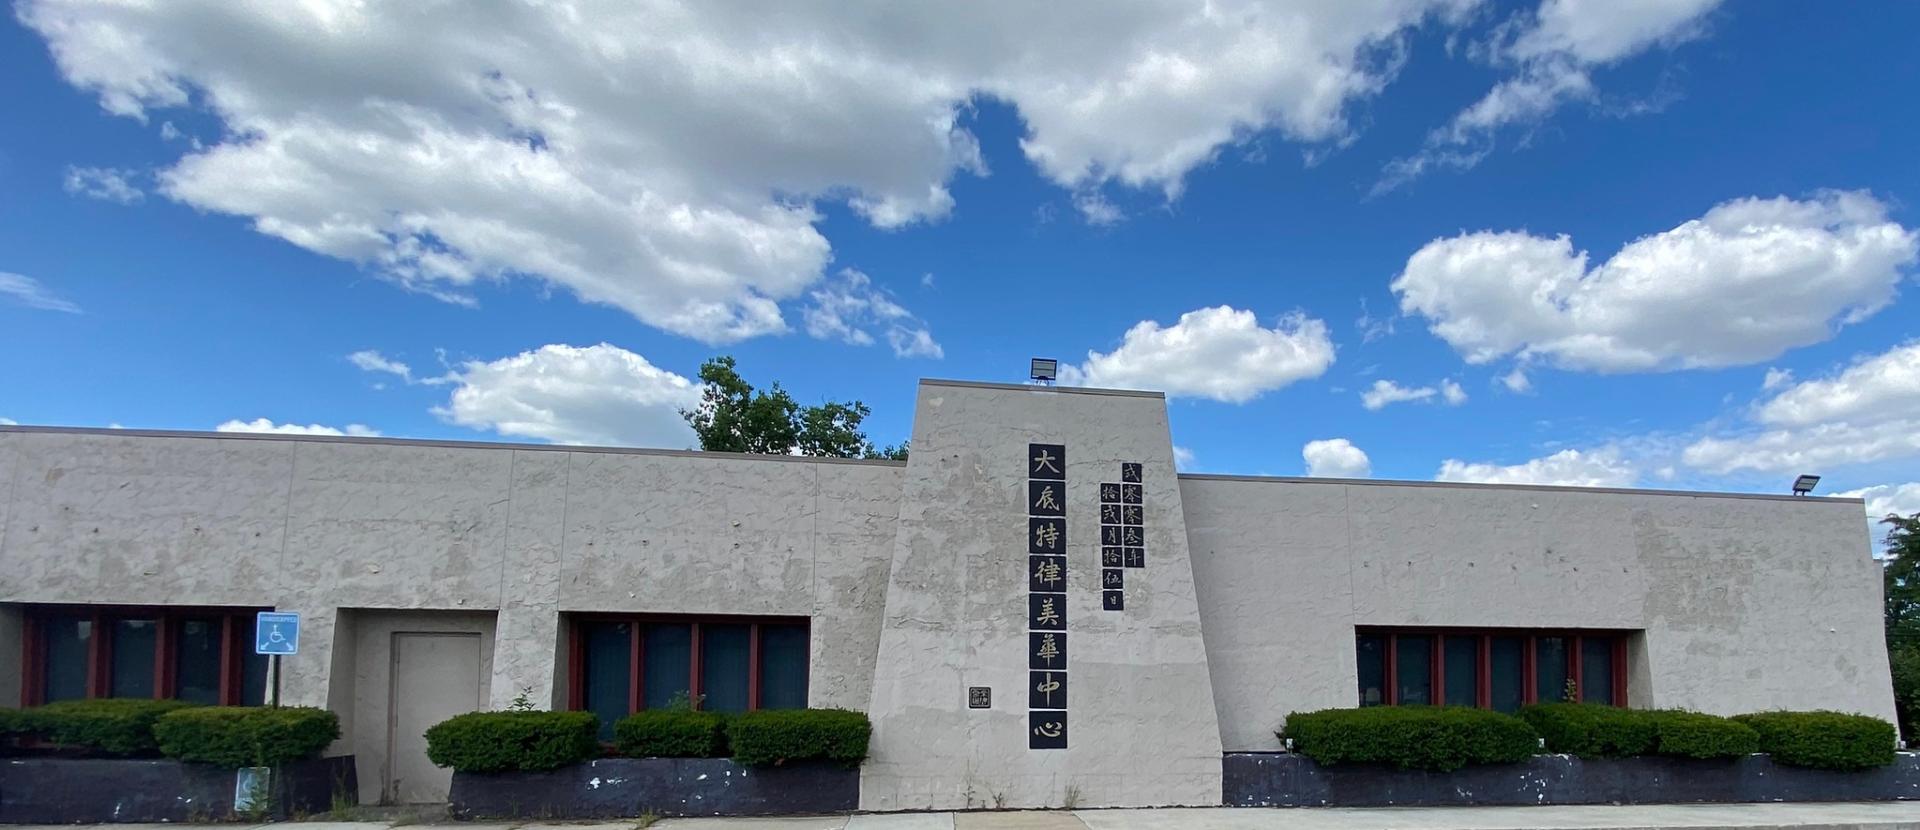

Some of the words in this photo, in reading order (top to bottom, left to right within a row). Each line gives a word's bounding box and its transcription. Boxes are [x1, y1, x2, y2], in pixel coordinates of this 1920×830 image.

[1033, 449, 1064, 738] 大底特律美華中心
